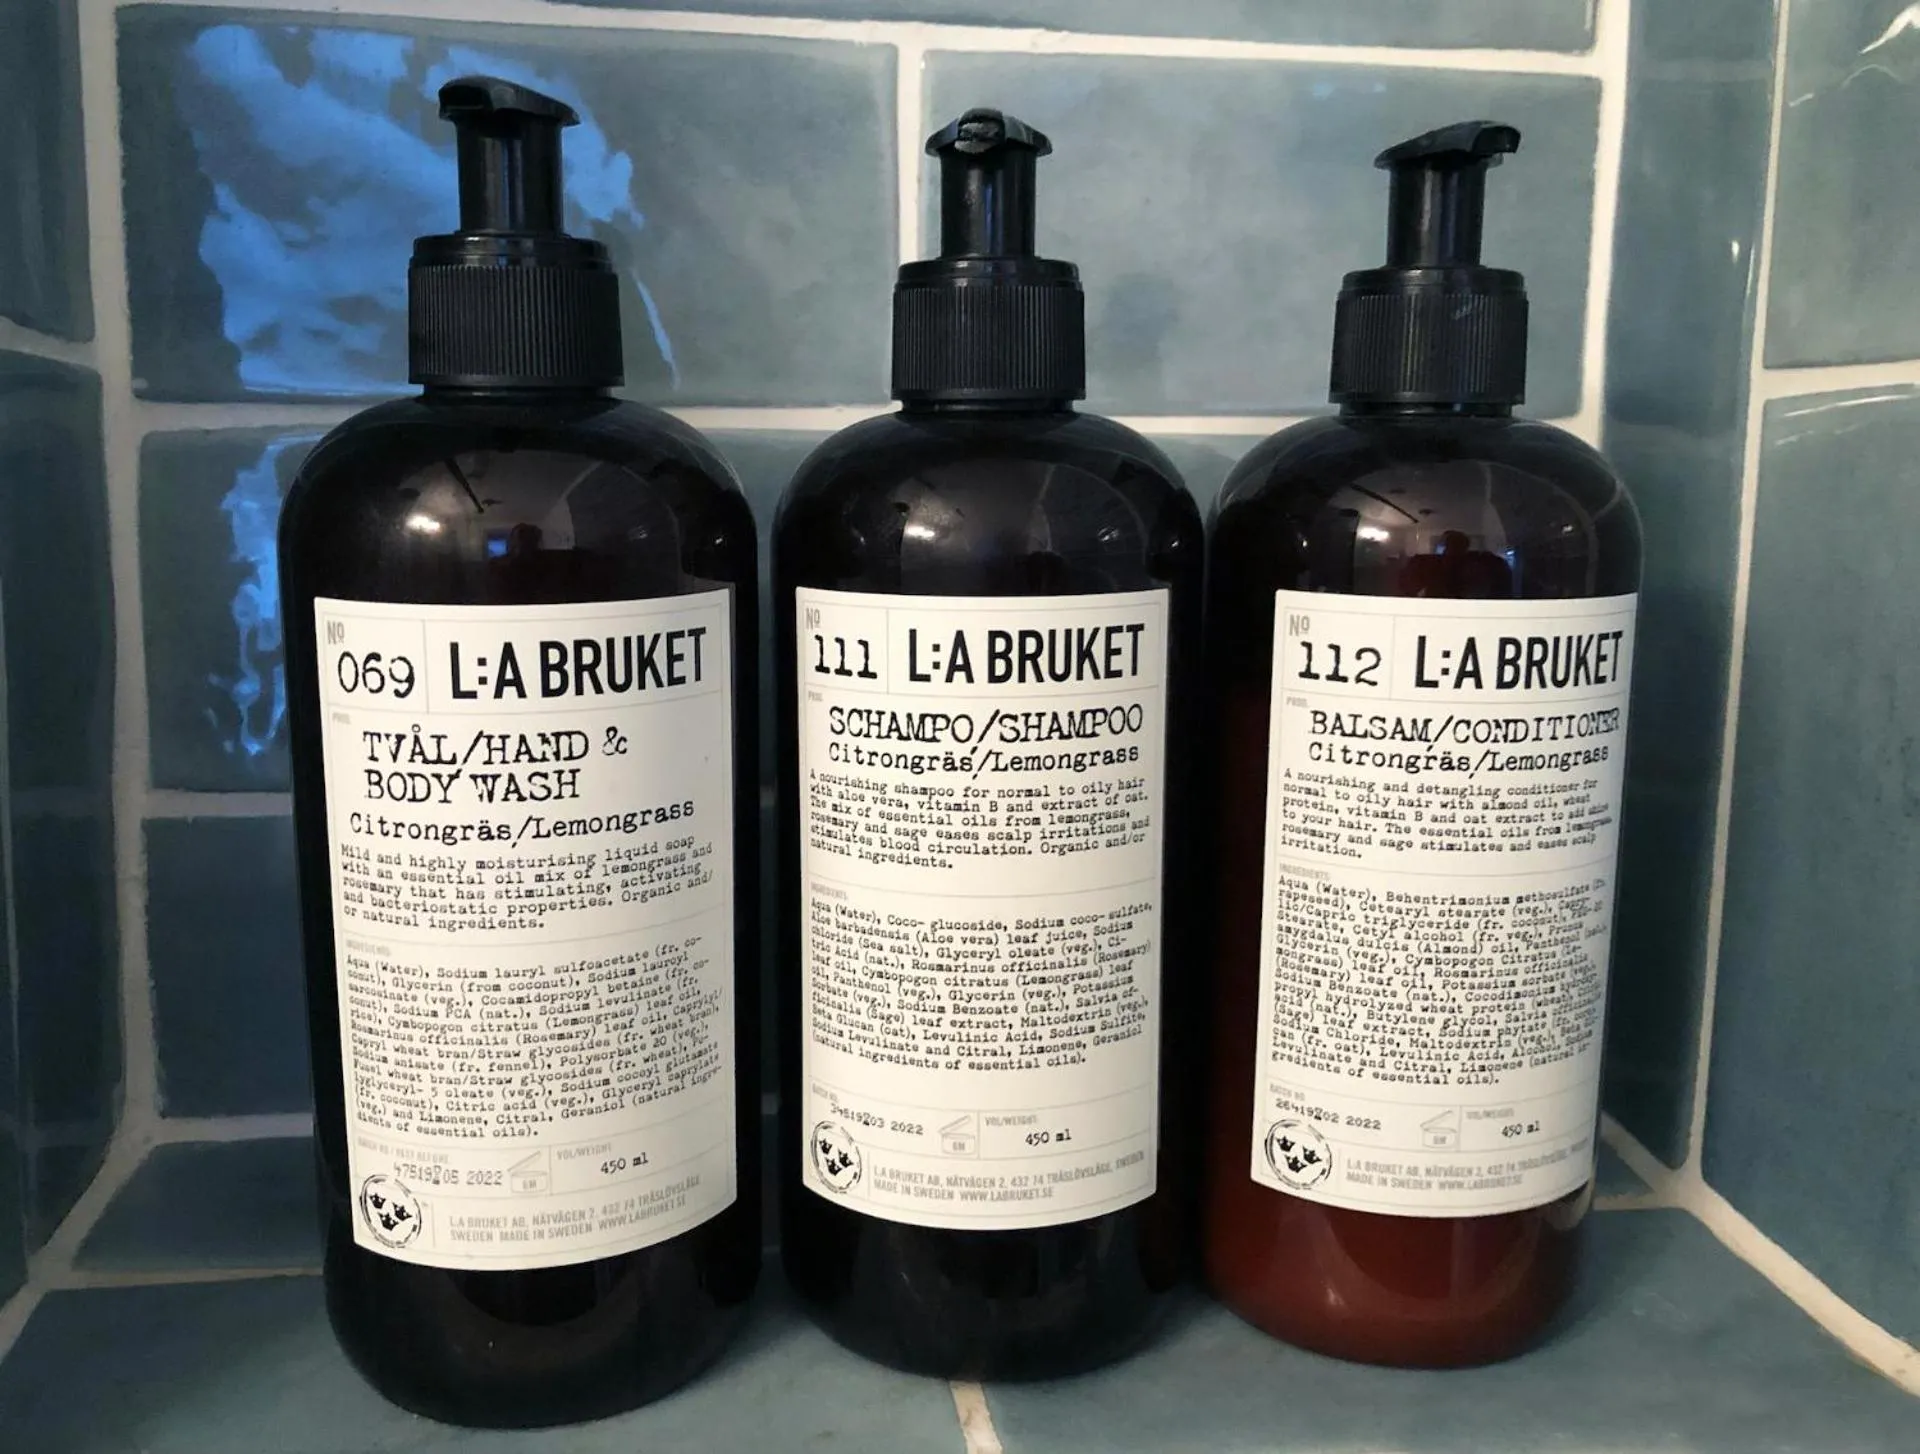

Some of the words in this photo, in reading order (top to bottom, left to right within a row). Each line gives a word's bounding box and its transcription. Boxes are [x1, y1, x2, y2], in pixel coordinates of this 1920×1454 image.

[449, 641, 528, 700] L:A
[539, 626, 707, 699] BRUKET
[814, 634, 878, 680] 111
[908, 628, 975, 684] L:A
[987, 622, 1145, 684] BRUKET
[1298, 640, 1382, 687] 112
[1414, 635, 1484, 690] L:A
[1495, 630, 1624, 690] BRUKET
[337, 650, 416, 699] 069
[362, 723, 590, 763] TVÅL/HAND
[828, 703, 1144, 756] SCHAMPO/SHAMPOO
[828, 741, 1139, 781] Citrongräs/Lemongrass
[1308, 741, 1609, 780] Citrongräs/Lemongrass
[363, 768, 463, 804] BODY
[468, 767, 582, 804] WASH
[349, 800, 695, 849] Citrongräs/Lemongrass
[890, 1120, 924, 1136] 2022
[1024, 1130, 1051, 1147] 450
[1055, 1128, 1073, 1143] ml
[1345, 1115, 1382, 1131] 2022
[1500, 1122, 1524, 1139] 450
[1526, 1120, 1541, 1134] ml
[465, 1169, 504, 1187] 2022
[599, 1157, 627, 1176] 450
[632, 1151, 649, 1168] ml
